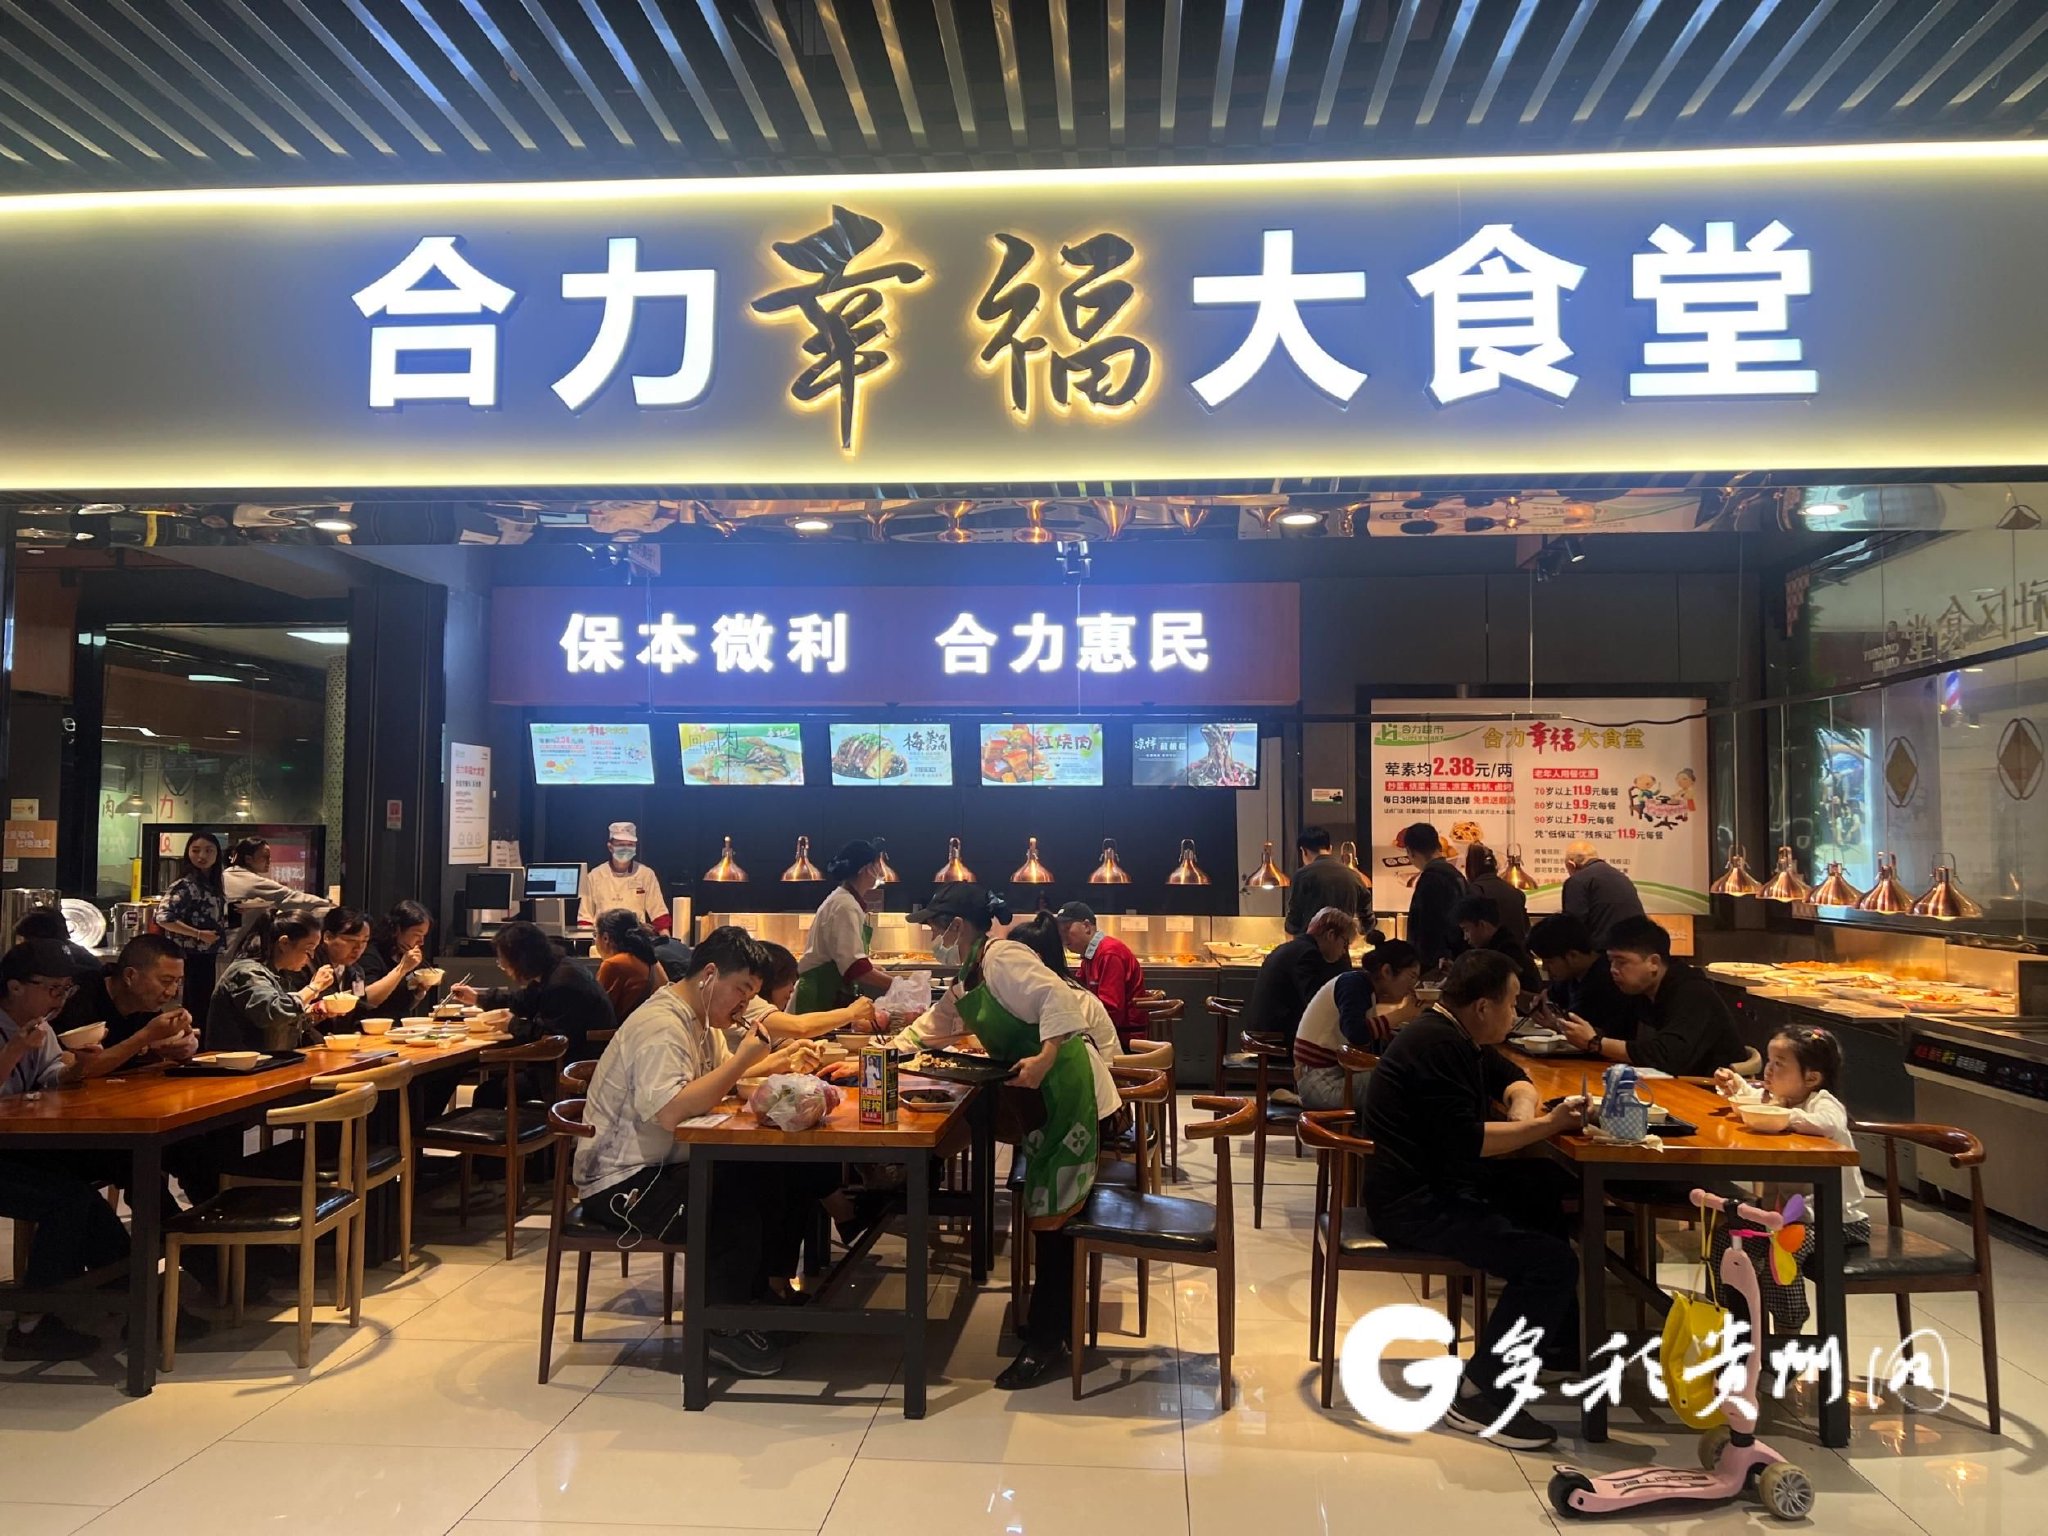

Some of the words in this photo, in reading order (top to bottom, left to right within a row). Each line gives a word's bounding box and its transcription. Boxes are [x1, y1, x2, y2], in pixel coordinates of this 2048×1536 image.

[351, 205, 1821, 450] 合力幸福大食堂
[559, 612, 849, 674] 保本微利
[934, 612, 1211, 674] 合力惠民
[1402, 724, 1444, 735] 合力超市
[1482, 721, 1646, 754] 合力幸福大食堂
[1033, 733, 1093, 751] 红烧肉
[1385, 757, 1513, 778] 荤素均2.38元/两
[1534, 785, 1619, 796] 70岁以上11.9元每餐
[1534, 799, 1616, 810] 80岁以上9.9元每餐
[1534, 813, 1615, 825] 90岁以上7.9元每餐
